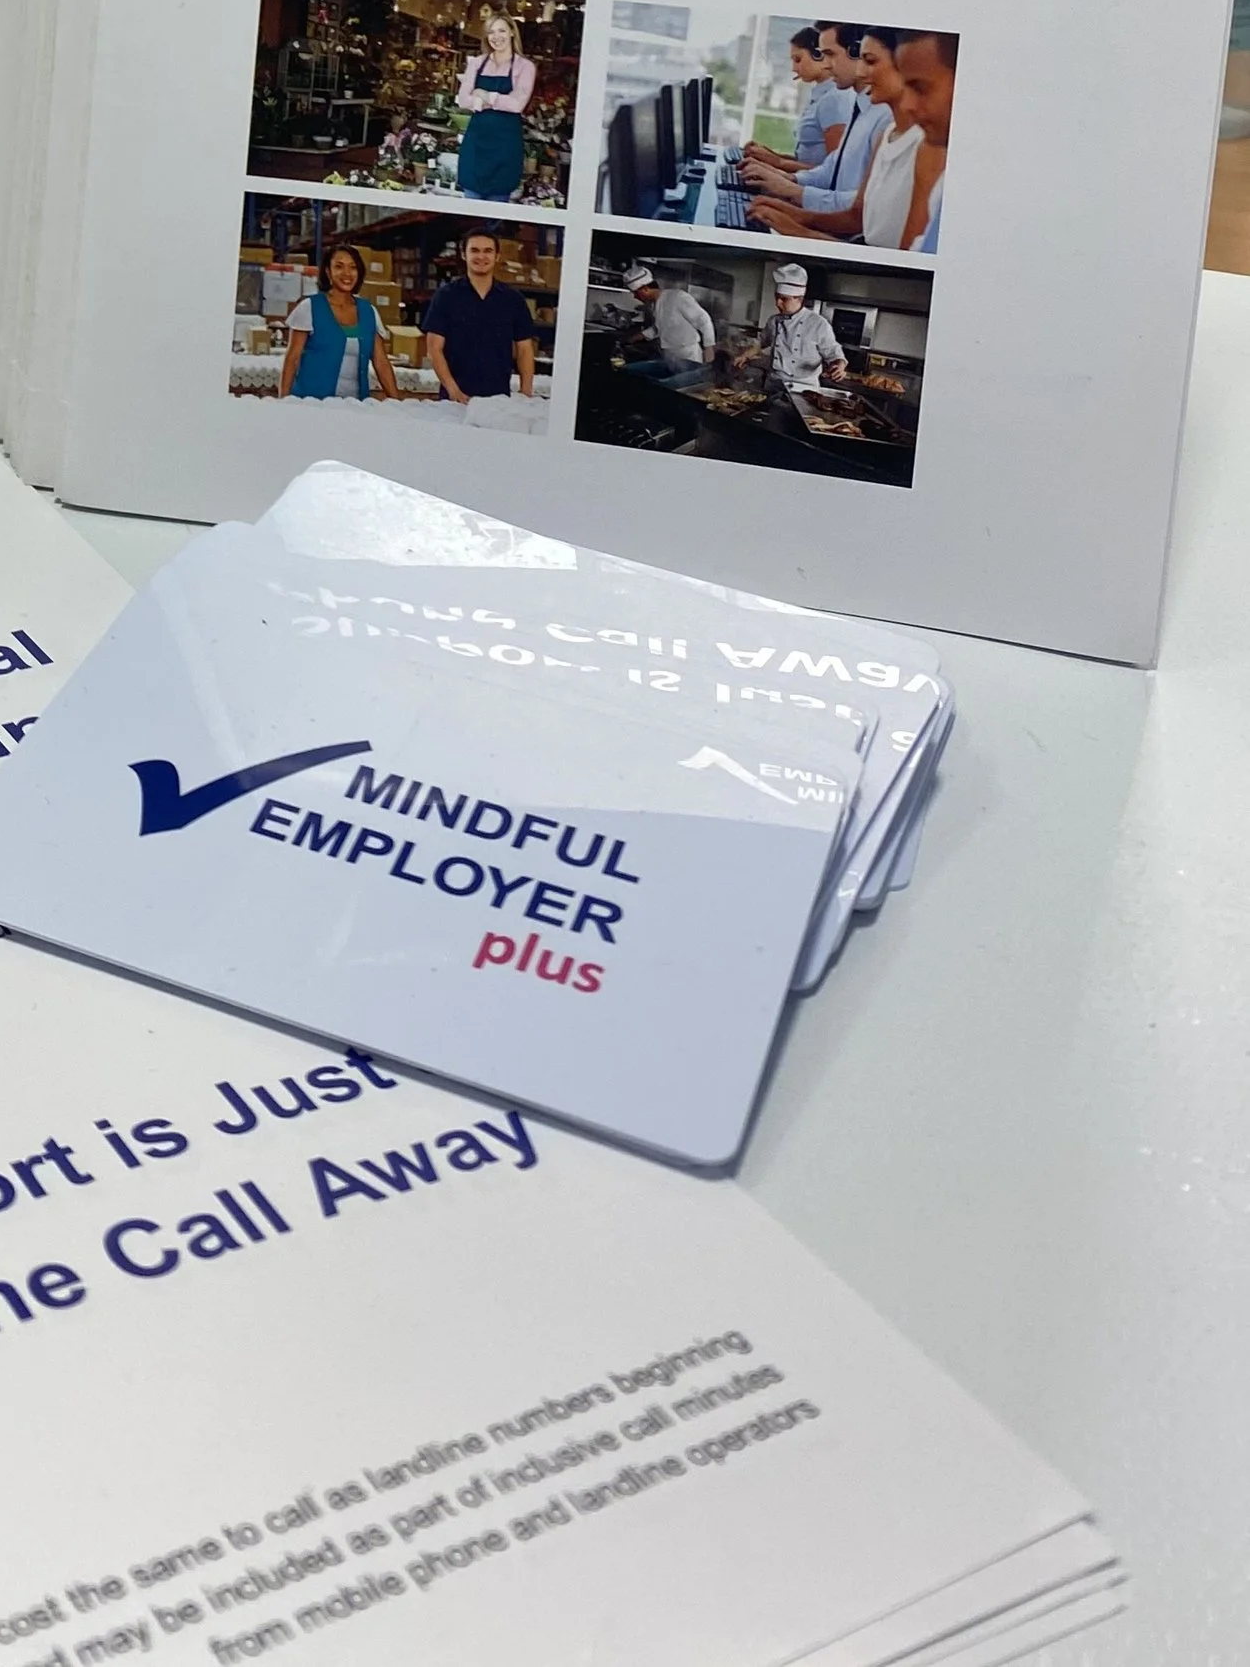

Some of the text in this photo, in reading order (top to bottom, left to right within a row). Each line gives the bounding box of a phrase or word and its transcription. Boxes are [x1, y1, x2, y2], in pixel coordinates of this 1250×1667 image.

[250, 798, 623, 944] EMPLOYER
[344, 765, 640, 884] MINDFUL
[472, 931, 605, 993] plus
[94, 1117, 189, 1169] is
[213, 1044, 398, 1135] Just
[103, 1181, 292, 1279] Call
[308, 1109, 540, 1218] Away
[66, 1577, 127, 1613] the
[128, 1536, 225, 1588] same
[221, 1523, 264, 1551] to
[263, 1487, 321, 1534] call
[323, 1481, 369, 1510] as
[362, 1433, 489, 1493] landline
[487, 1383, 615, 1444] numbers
[608, 1330, 753, 1394] beginning
[73, 1618, 153, 1666] may
[152, 1599, 206, 1634] be
[205, 1536, 345, 1613] included
[346, 1523, 391, 1555] as
[389, 1494, 459, 1544] part
[455, 1475, 493, 1509] of
[486, 1431, 622, 1495] inclusive
[619, 1404, 676, 1441] call
[671, 1365, 784, 1421] minutes
[208, 1399, 821, 1666] from mobile phone and landline operators
